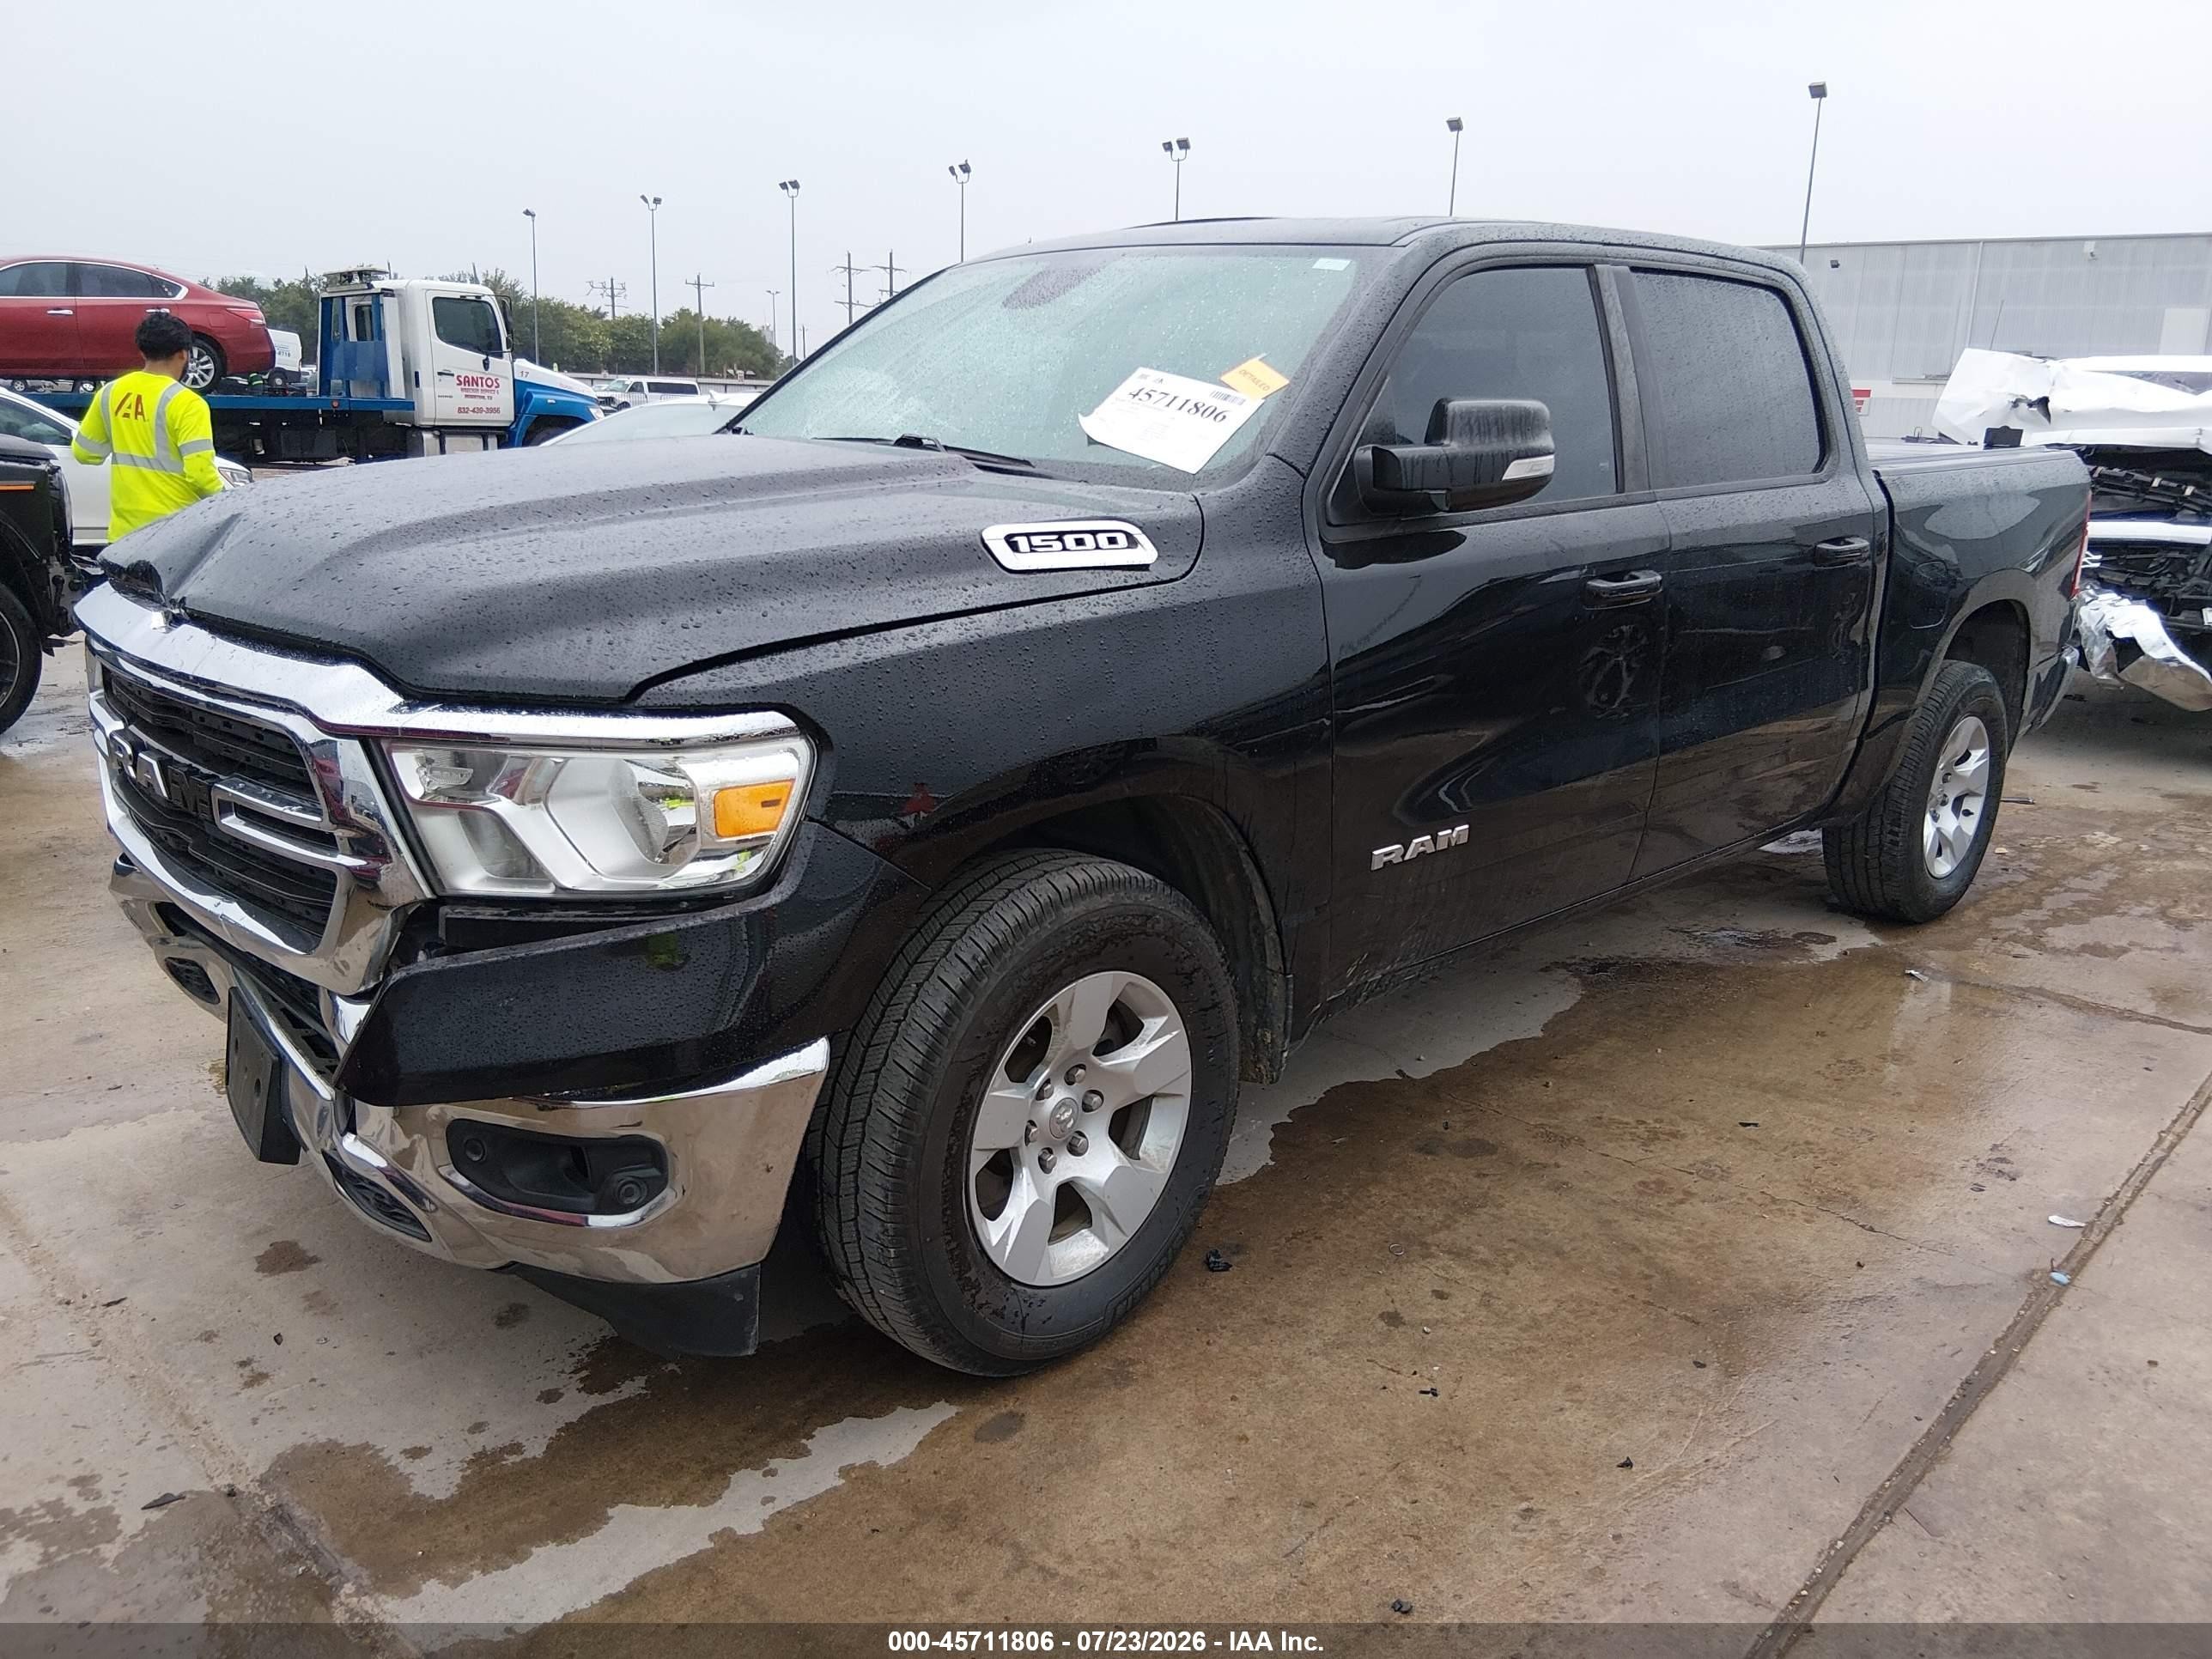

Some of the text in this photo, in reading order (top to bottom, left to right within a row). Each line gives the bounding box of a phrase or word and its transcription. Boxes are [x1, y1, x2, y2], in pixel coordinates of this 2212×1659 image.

[456, 374, 501, 389] SANTOS
[1238, 368, 1271, 392] DETAILED
[1128, 386, 1231, 423] 45711806
[1009, 532, 1128, 553] 1500
[109, 729, 215, 817] RAM
[1370, 824, 1470, 871] RAM
